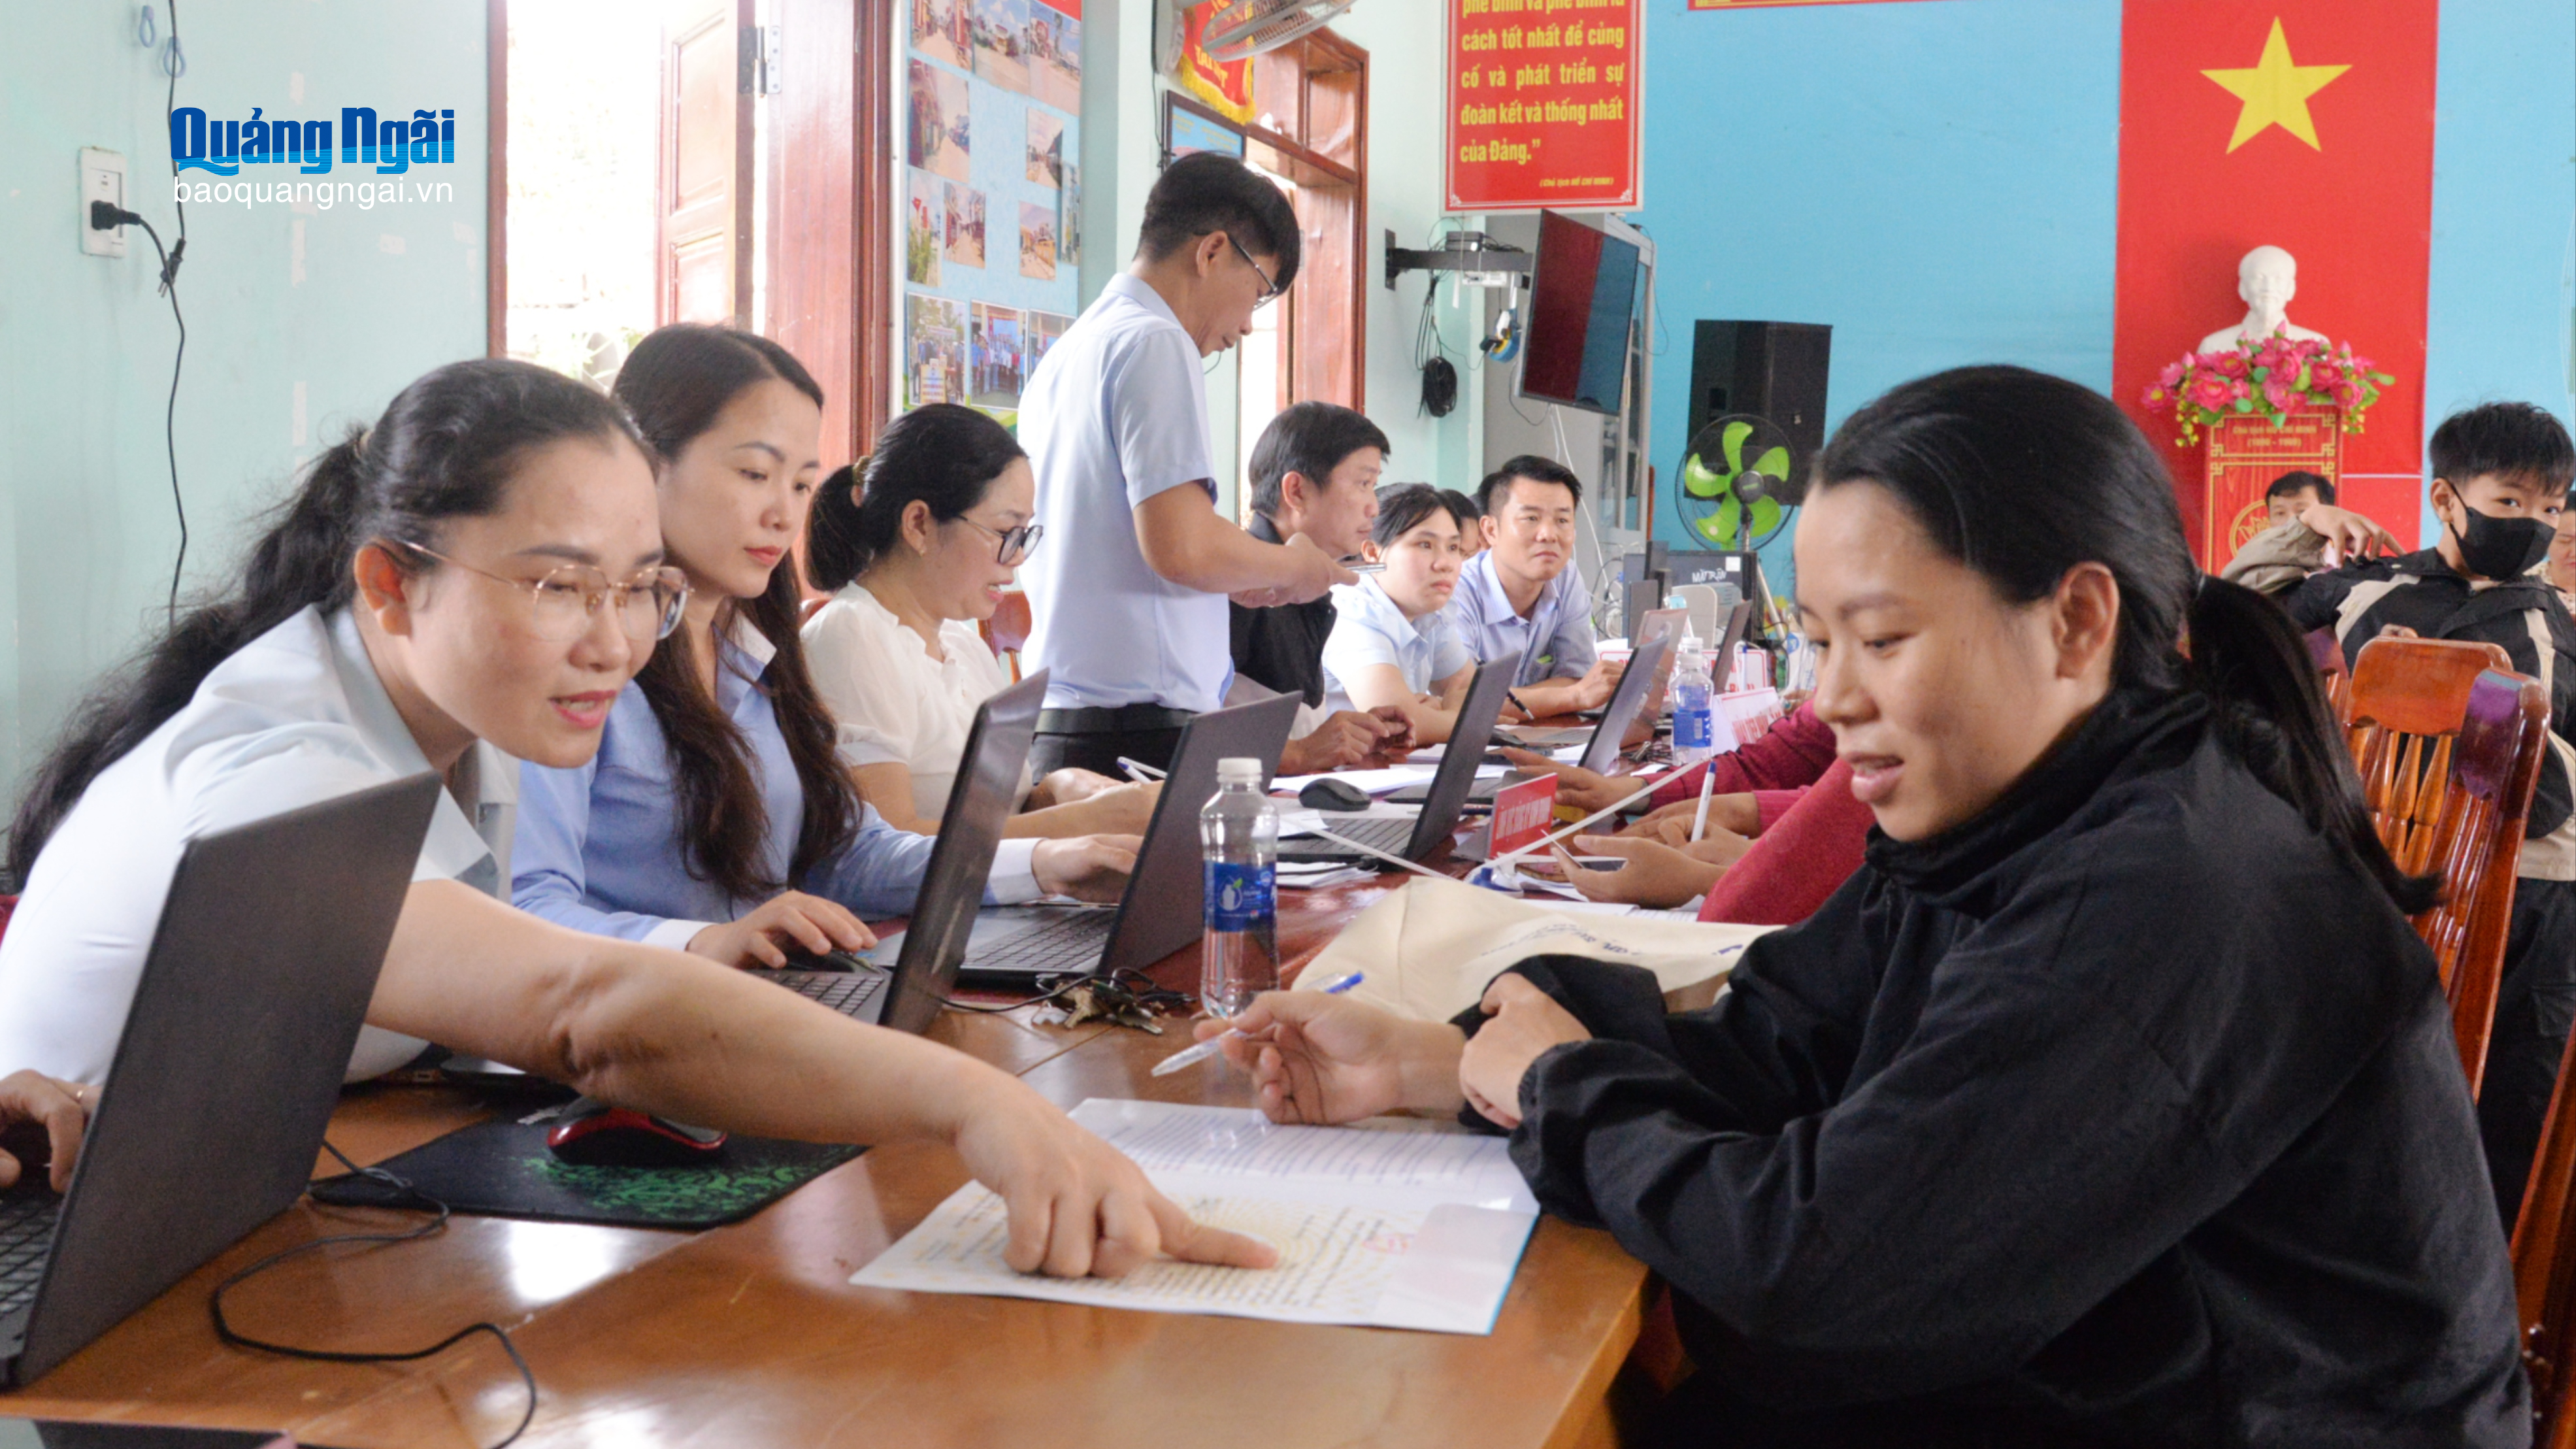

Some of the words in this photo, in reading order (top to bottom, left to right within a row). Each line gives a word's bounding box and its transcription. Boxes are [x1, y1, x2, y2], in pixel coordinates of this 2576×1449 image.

[1462, 28, 1497, 51] cách
[1502, 24, 1523, 49] tốt
[1527, 22, 1560, 48] nhất
[1564, 19, 1583, 46] để
[1588, 21, 1625, 49] củng
[1461, 63, 1481, 88] cố
[1489, 65, 1506, 87] và
[1516, 63, 1550, 91] phát
[1560, 56, 1596, 84] triển
[1606, 62, 1625, 87] sự
[1461, 103, 1496, 125] đoàn
[1499, 99, 1523, 124] kết
[1525, 101, 1542, 123] và
[1545, 97, 1587, 126] thống
[1590, 95, 1624, 120] nhất
[1461, 139, 1487, 163] của
